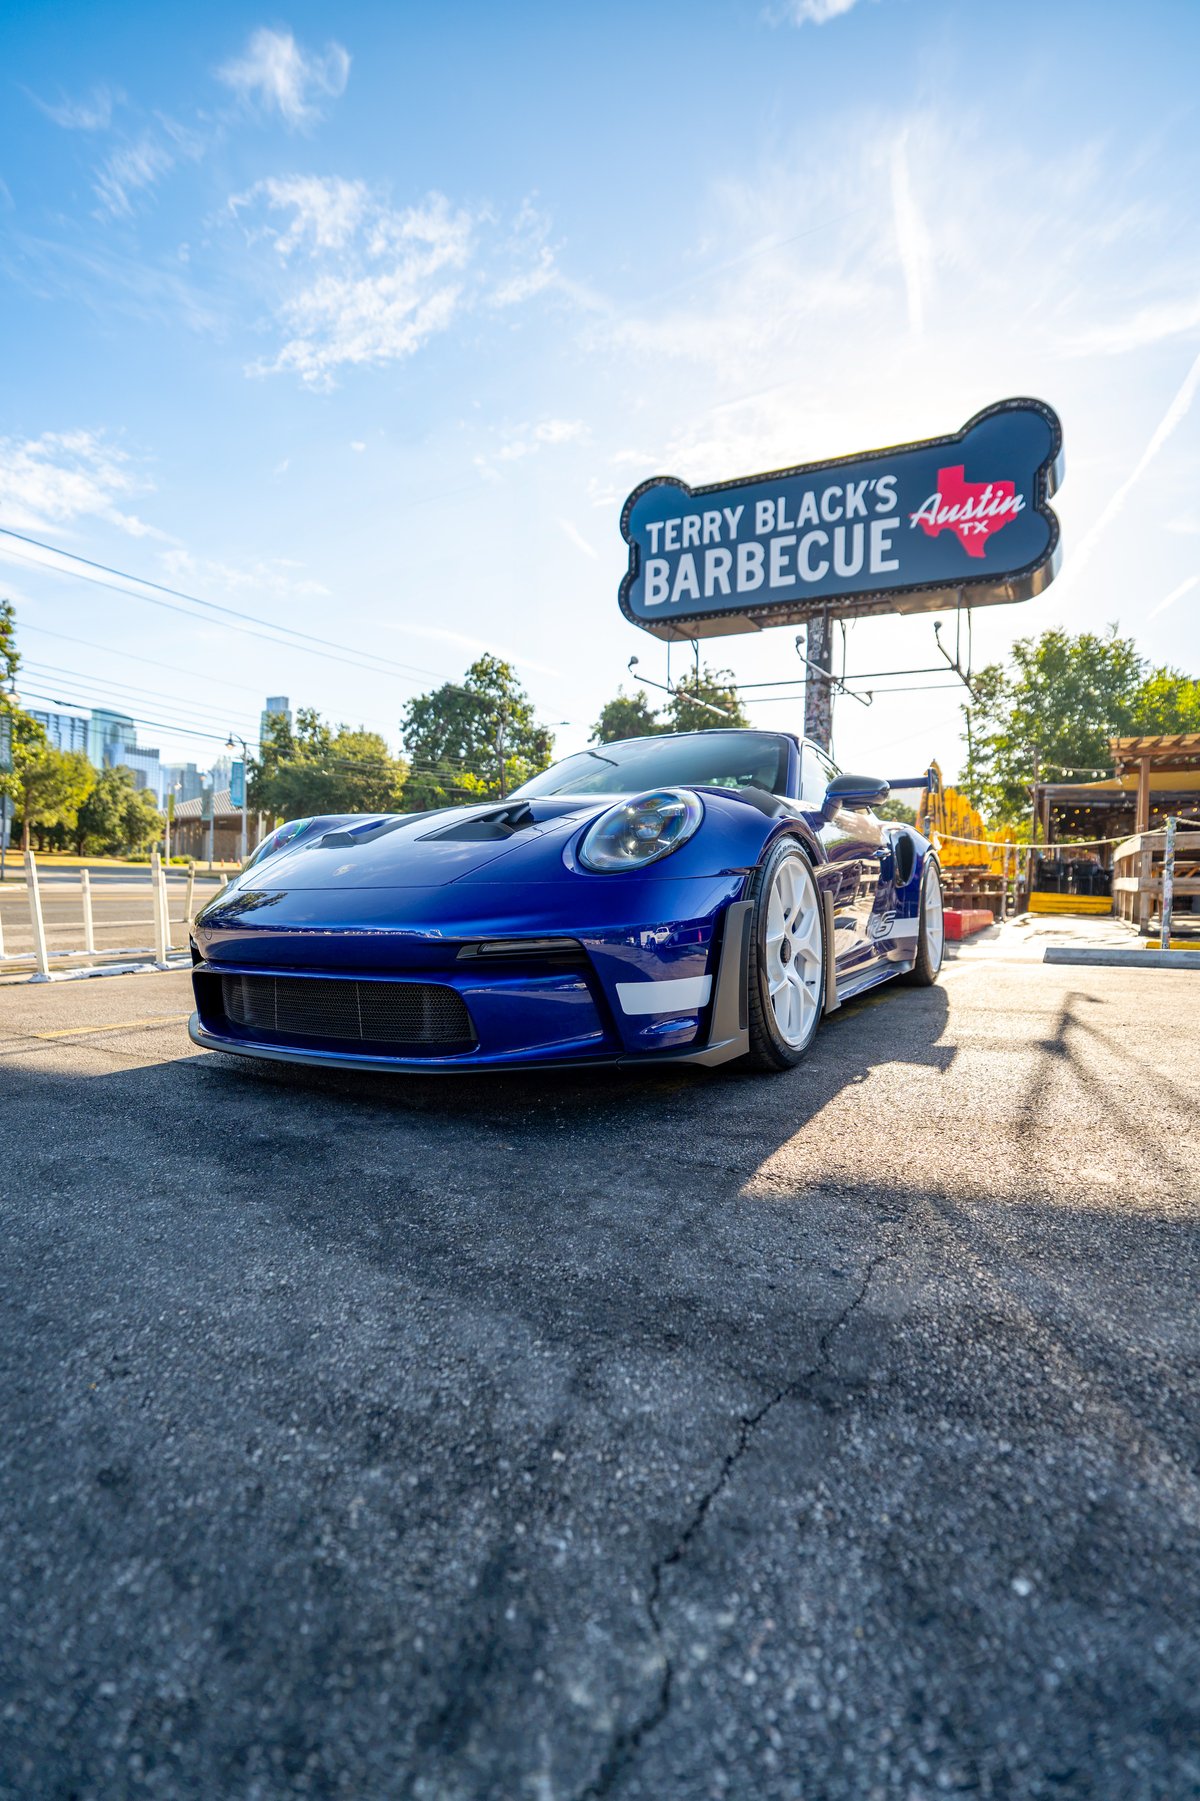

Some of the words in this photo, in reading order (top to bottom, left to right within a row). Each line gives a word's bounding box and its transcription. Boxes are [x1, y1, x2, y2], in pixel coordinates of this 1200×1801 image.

[645, 504, 745, 554] TERRY
[755, 475, 898, 535] BLACK'S
[909, 484, 1026, 529] Austin
[959, 519, 989, 536] TX
[644, 516, 900, 606] BARBECUE
